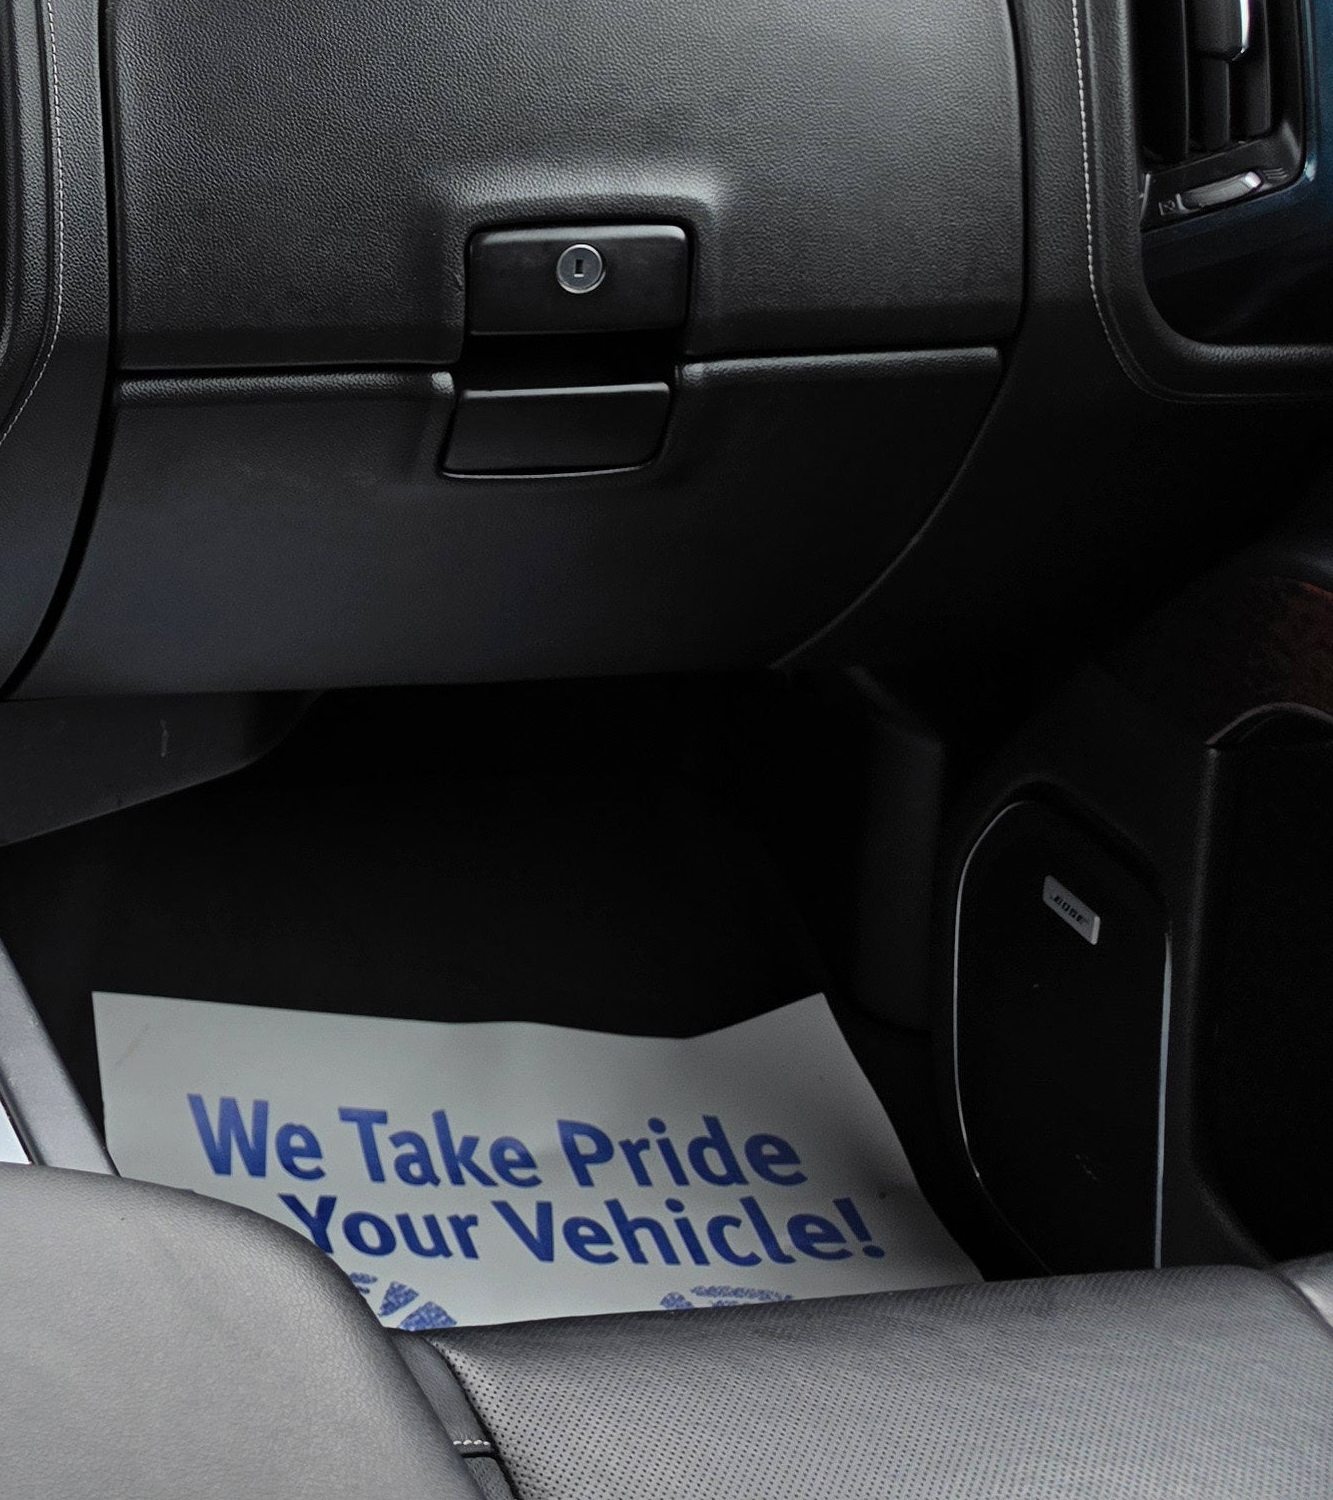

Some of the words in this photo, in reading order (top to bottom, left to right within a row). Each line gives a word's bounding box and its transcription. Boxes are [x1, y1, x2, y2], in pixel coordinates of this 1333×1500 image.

[186, 1093, 328, 1181] We
[338, 1106, 544, 1189] Take
[556, 1114, 808, 1191] Pride
[278, 1193, 483, 1260] Your
[491, 1196, 887, 1267] Vehicle!
